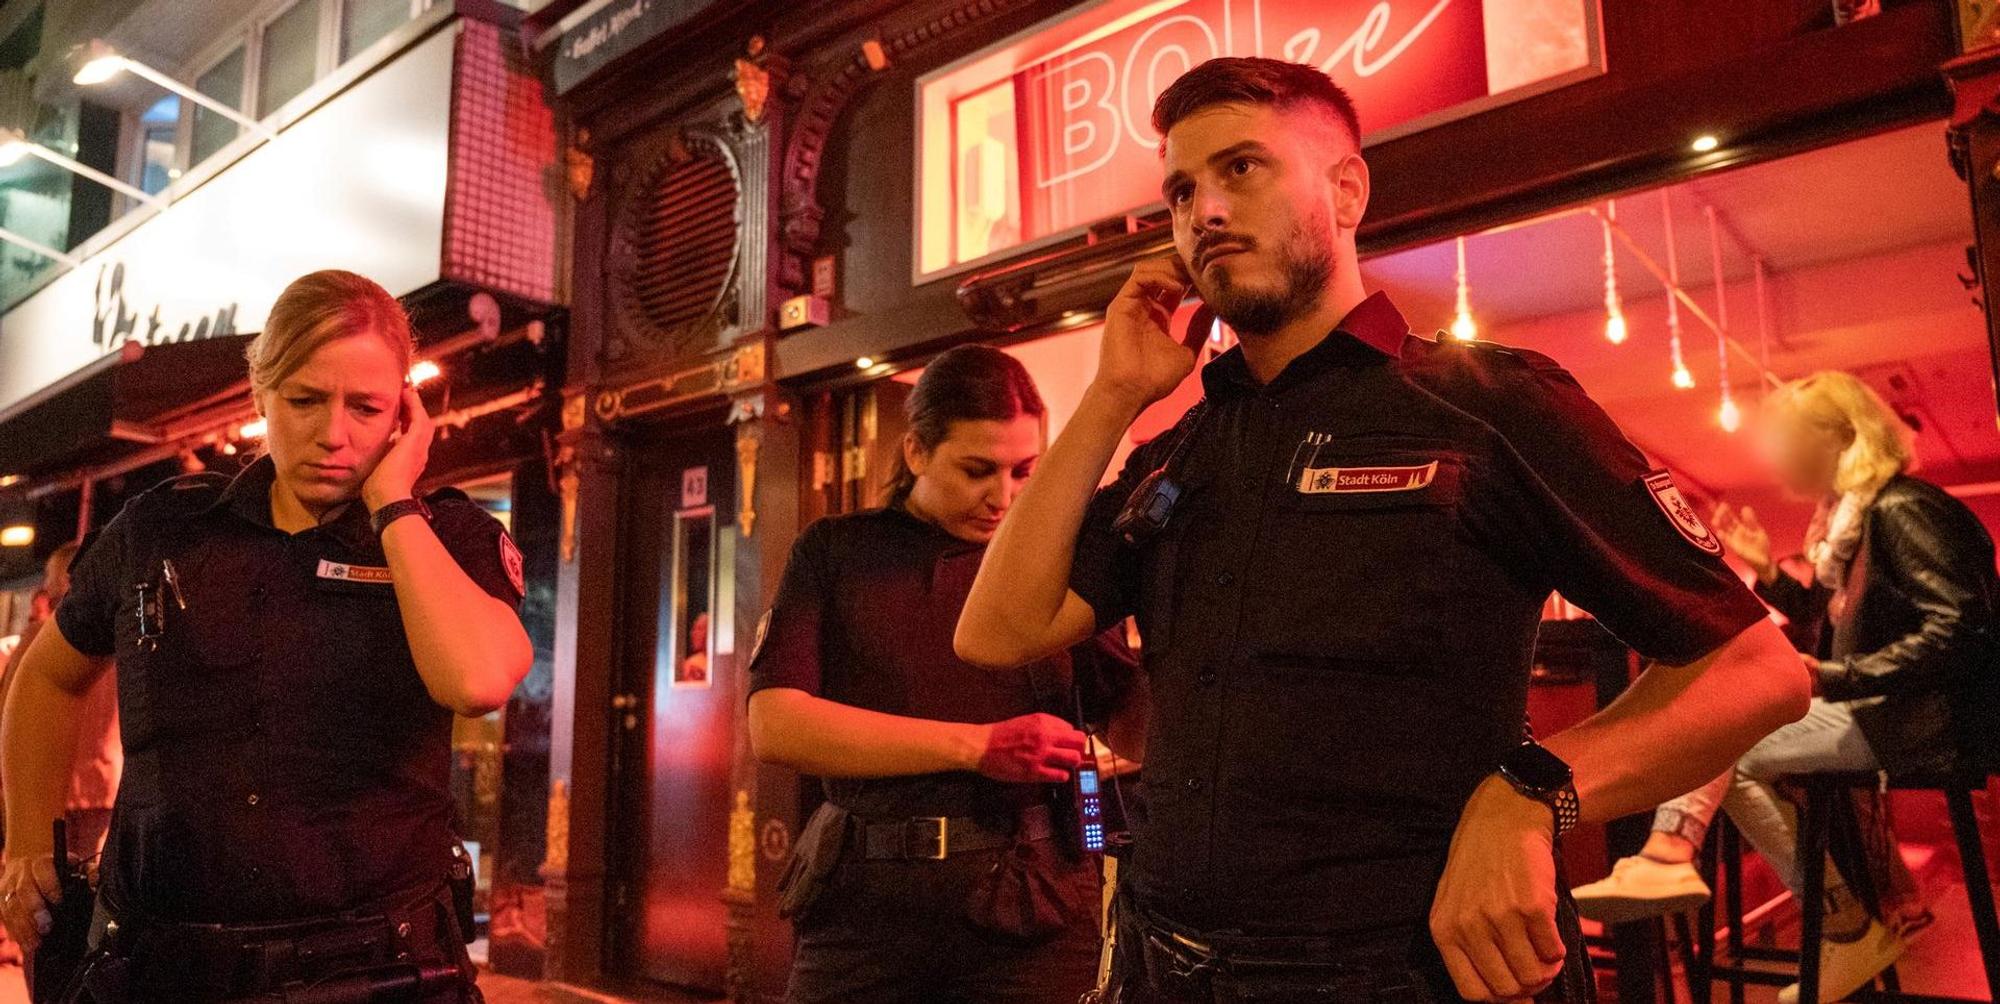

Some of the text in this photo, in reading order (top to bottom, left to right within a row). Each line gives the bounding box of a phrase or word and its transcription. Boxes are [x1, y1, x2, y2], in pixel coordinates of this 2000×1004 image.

[1338, 473, 1399, 486] Stadt Köln
[350, 569, 393, 579] Stadt Köl
